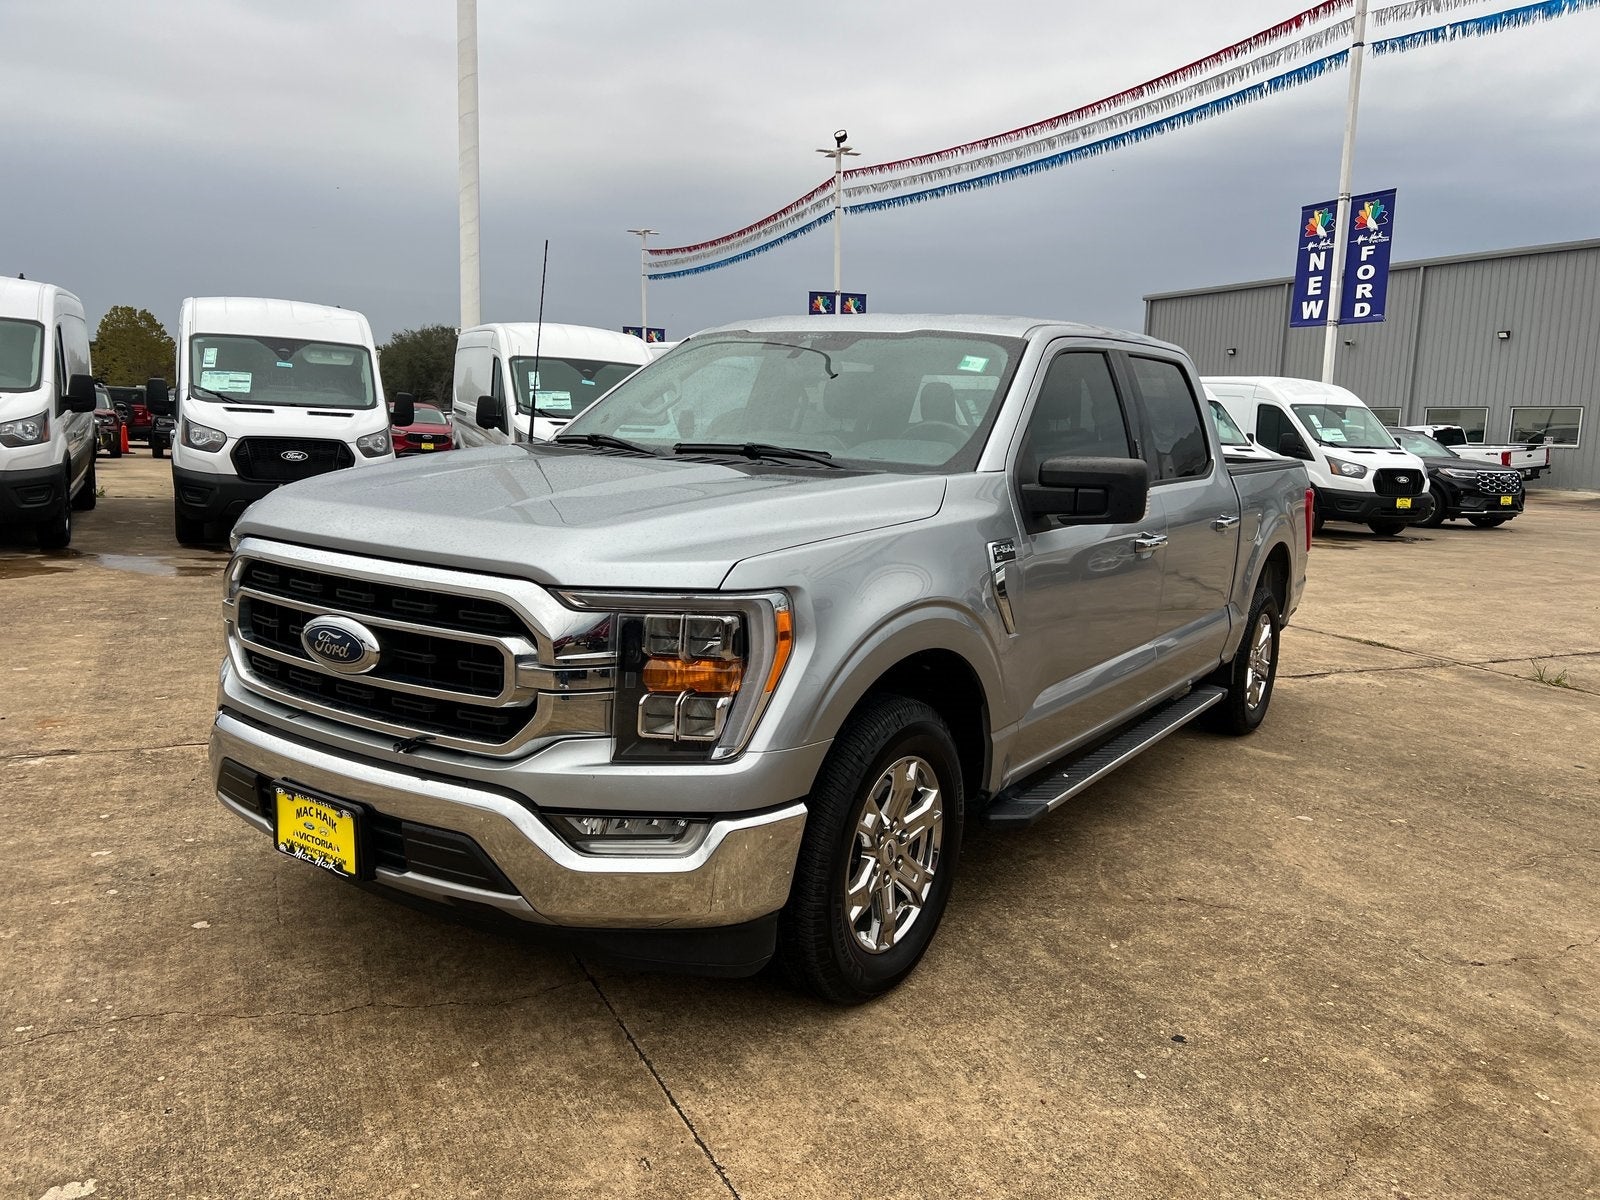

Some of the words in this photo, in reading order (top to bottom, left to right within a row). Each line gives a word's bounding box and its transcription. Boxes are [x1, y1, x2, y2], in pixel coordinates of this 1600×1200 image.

[1302, 251, 1326, 320] NEW
[1353, 245, 1376, 318] FORD
[314, 630, 352, 658] Ford
[295, 806, 314, 820] MAC
[315, 809, 338, 834] HAIK
[299, 831, 334, 849] VICTORIA
[294, 848, 315, 863] Mac
[315, 856, 339, 871] Haik
